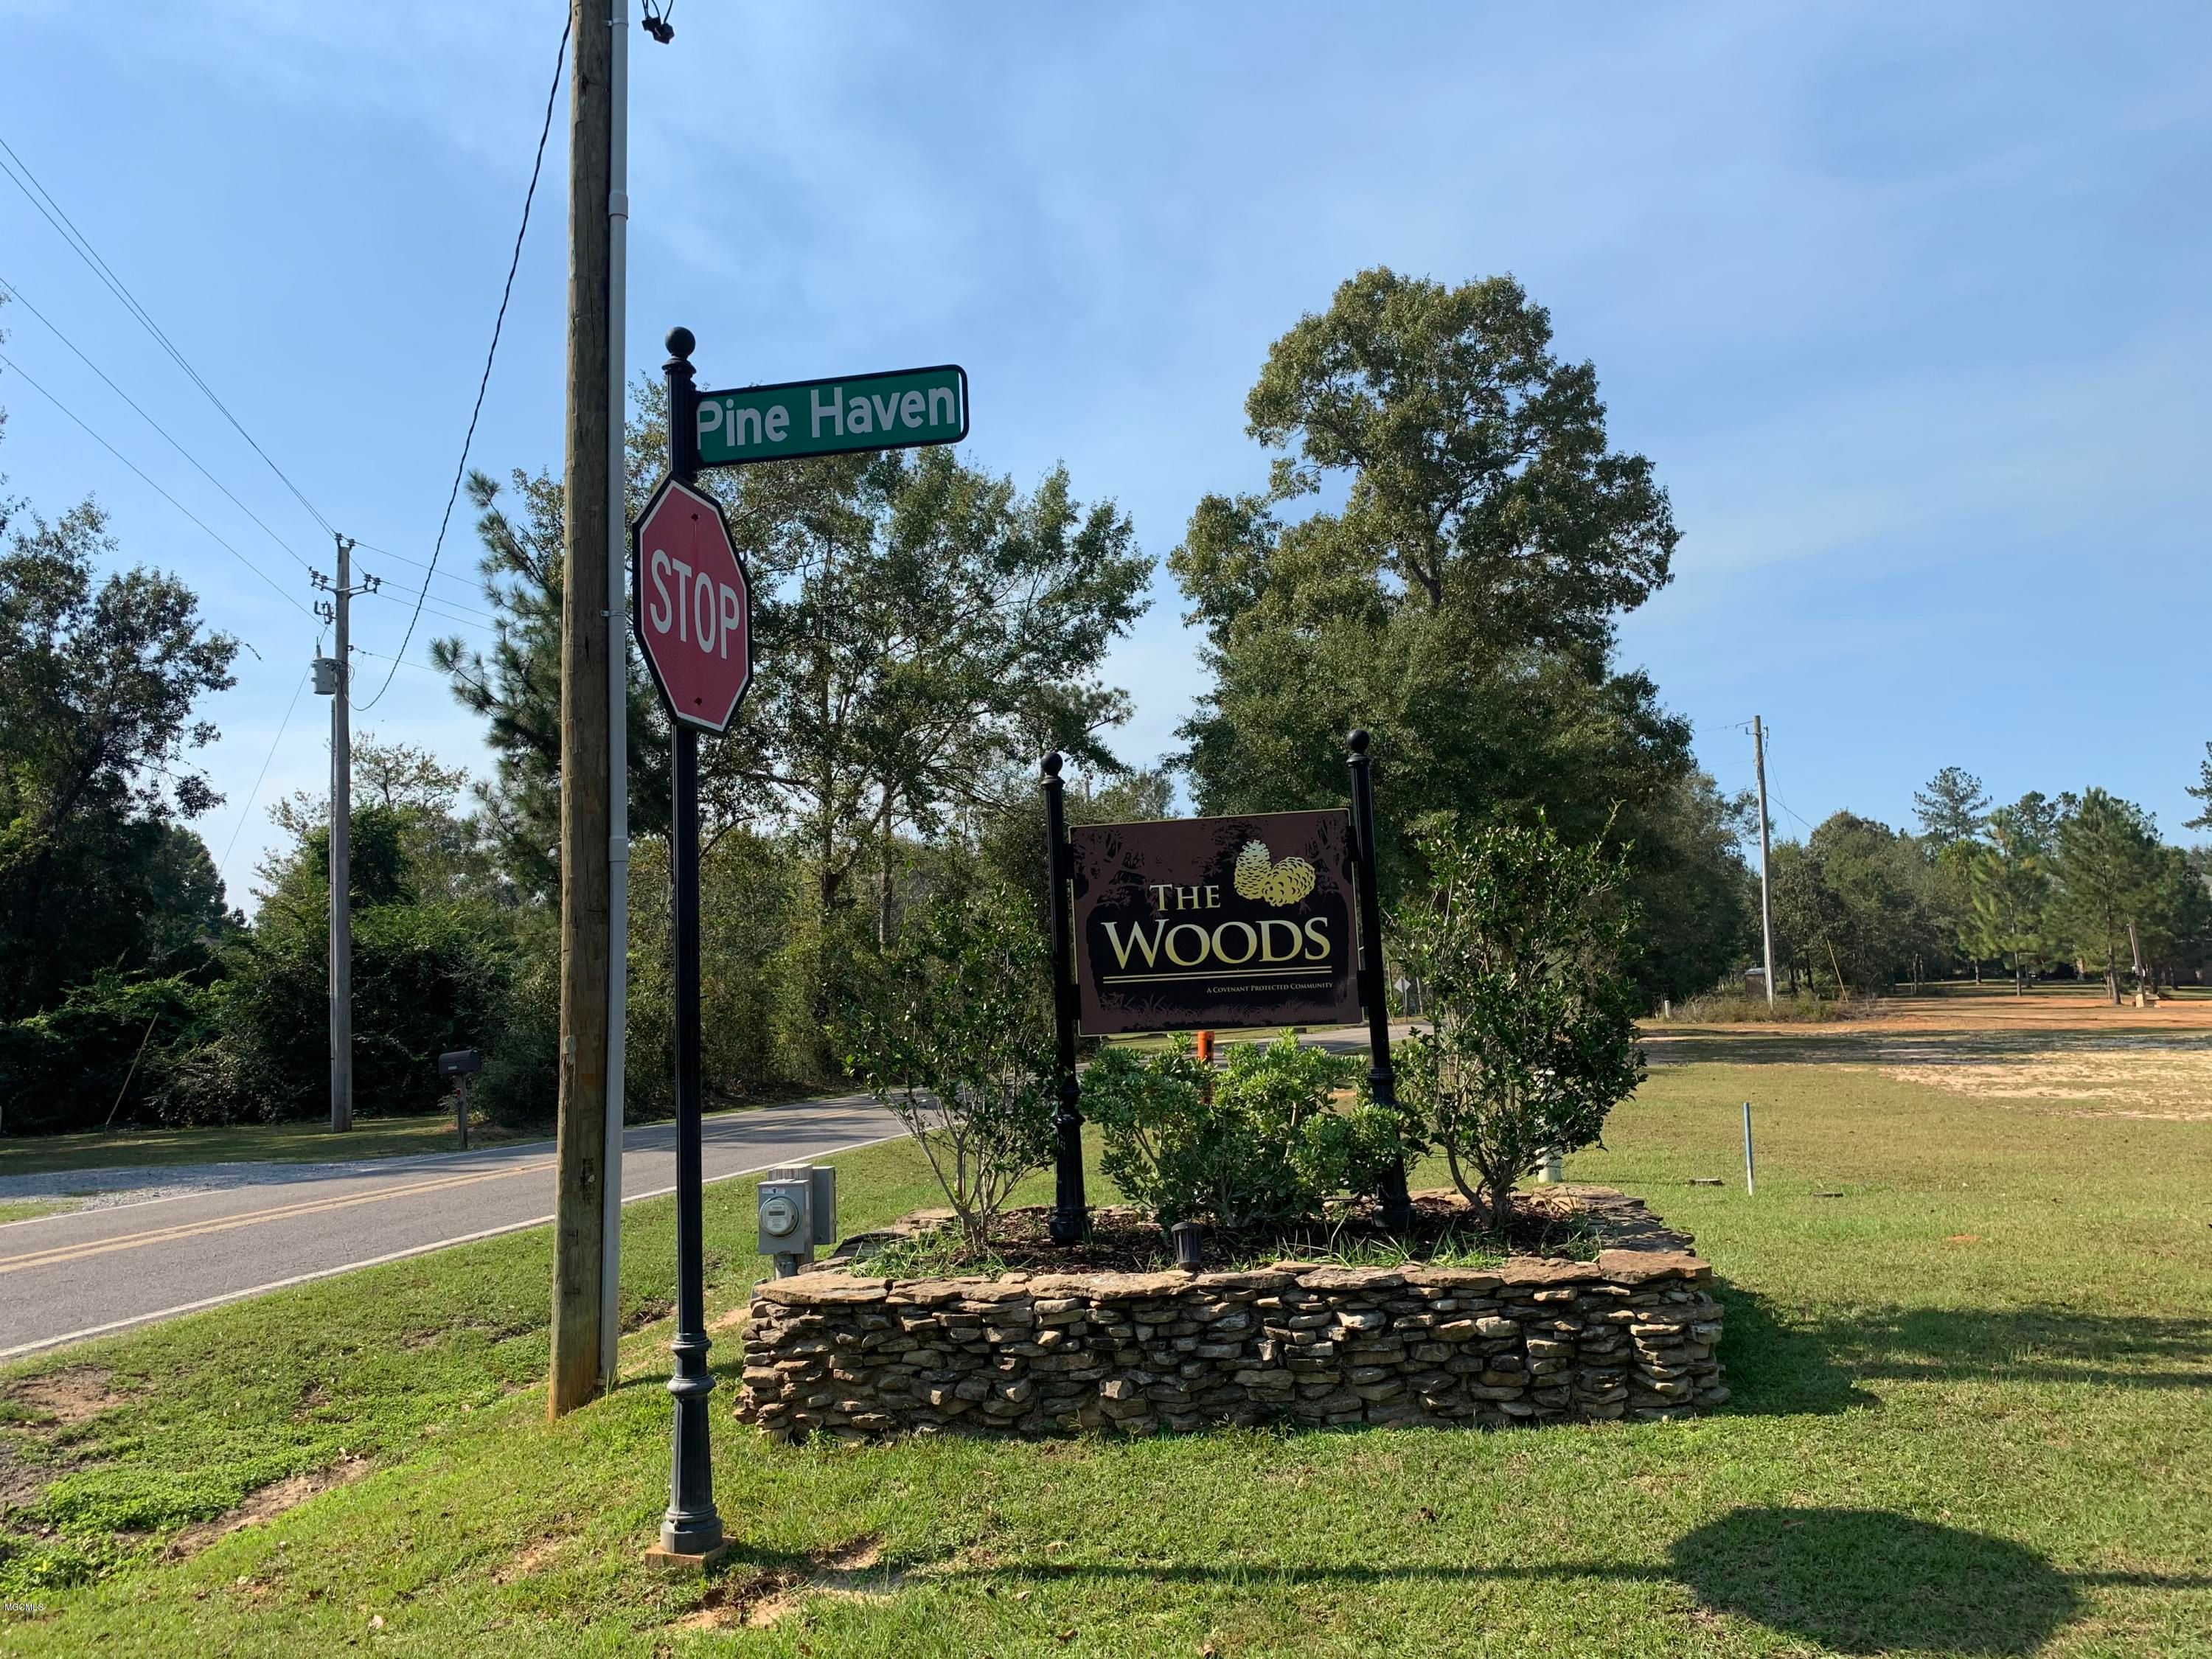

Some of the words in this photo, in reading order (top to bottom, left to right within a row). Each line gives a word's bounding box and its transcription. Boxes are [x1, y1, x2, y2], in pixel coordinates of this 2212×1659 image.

[696, 398, 790, 450] Pine
[810, 386, 956, 438] Haven
[650, 549, 740, 659] STOP
[1150, 884, 1221, 911] THE
[1100, 917, 1331, 970] WOODS
[1251, 984, 1289, 992] PROTECTED
[1290, 982, 1333, 990] COMMUNITY
